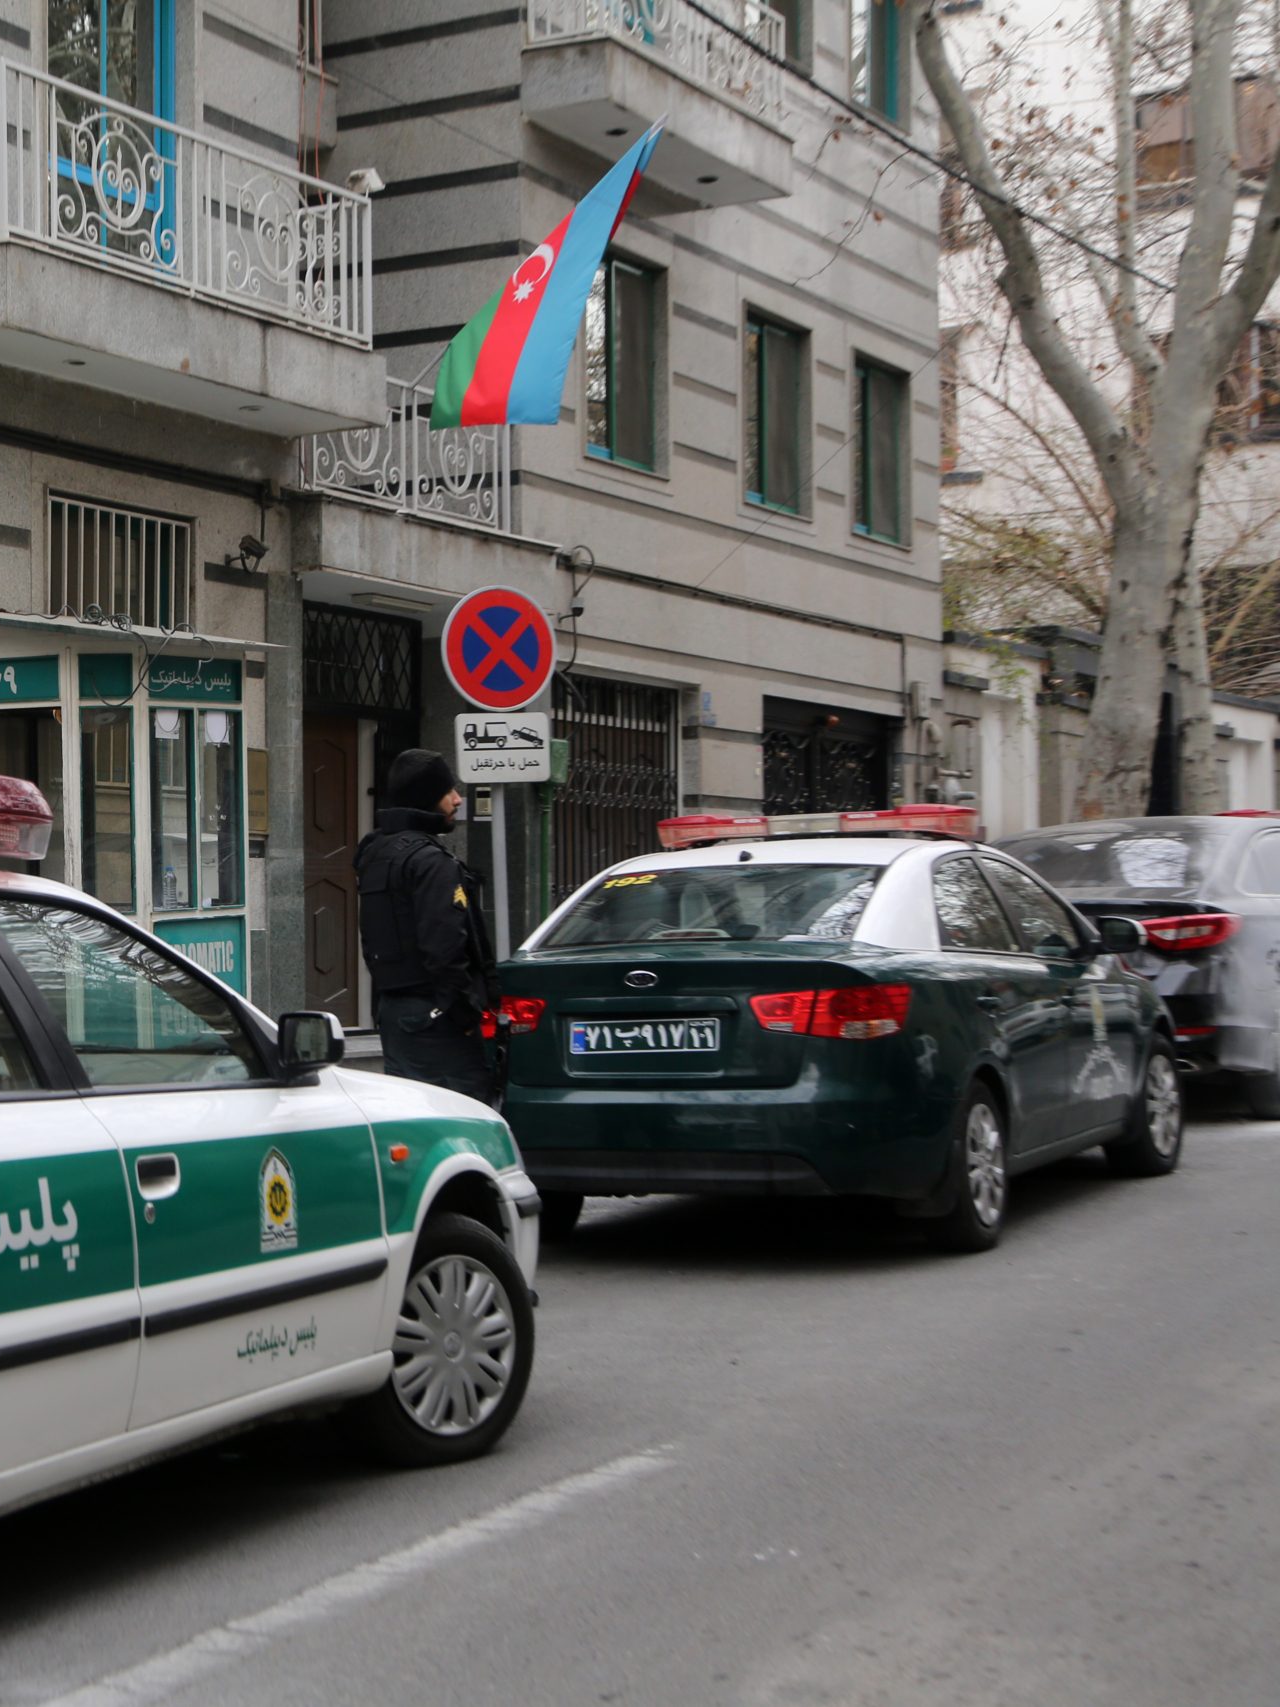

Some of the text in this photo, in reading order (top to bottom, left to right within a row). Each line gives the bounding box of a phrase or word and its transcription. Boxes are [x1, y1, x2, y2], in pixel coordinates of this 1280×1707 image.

[204, 672, 232, 692] پلیس
[508, 757, 515, 770] با
[518, 757, 540, 771] حمل
[603, 874, 659, 889] 192
[170, 940, 235, 973] OMATIC
[237, 1314, 318, 1364] پلیس دیپلماتیک
